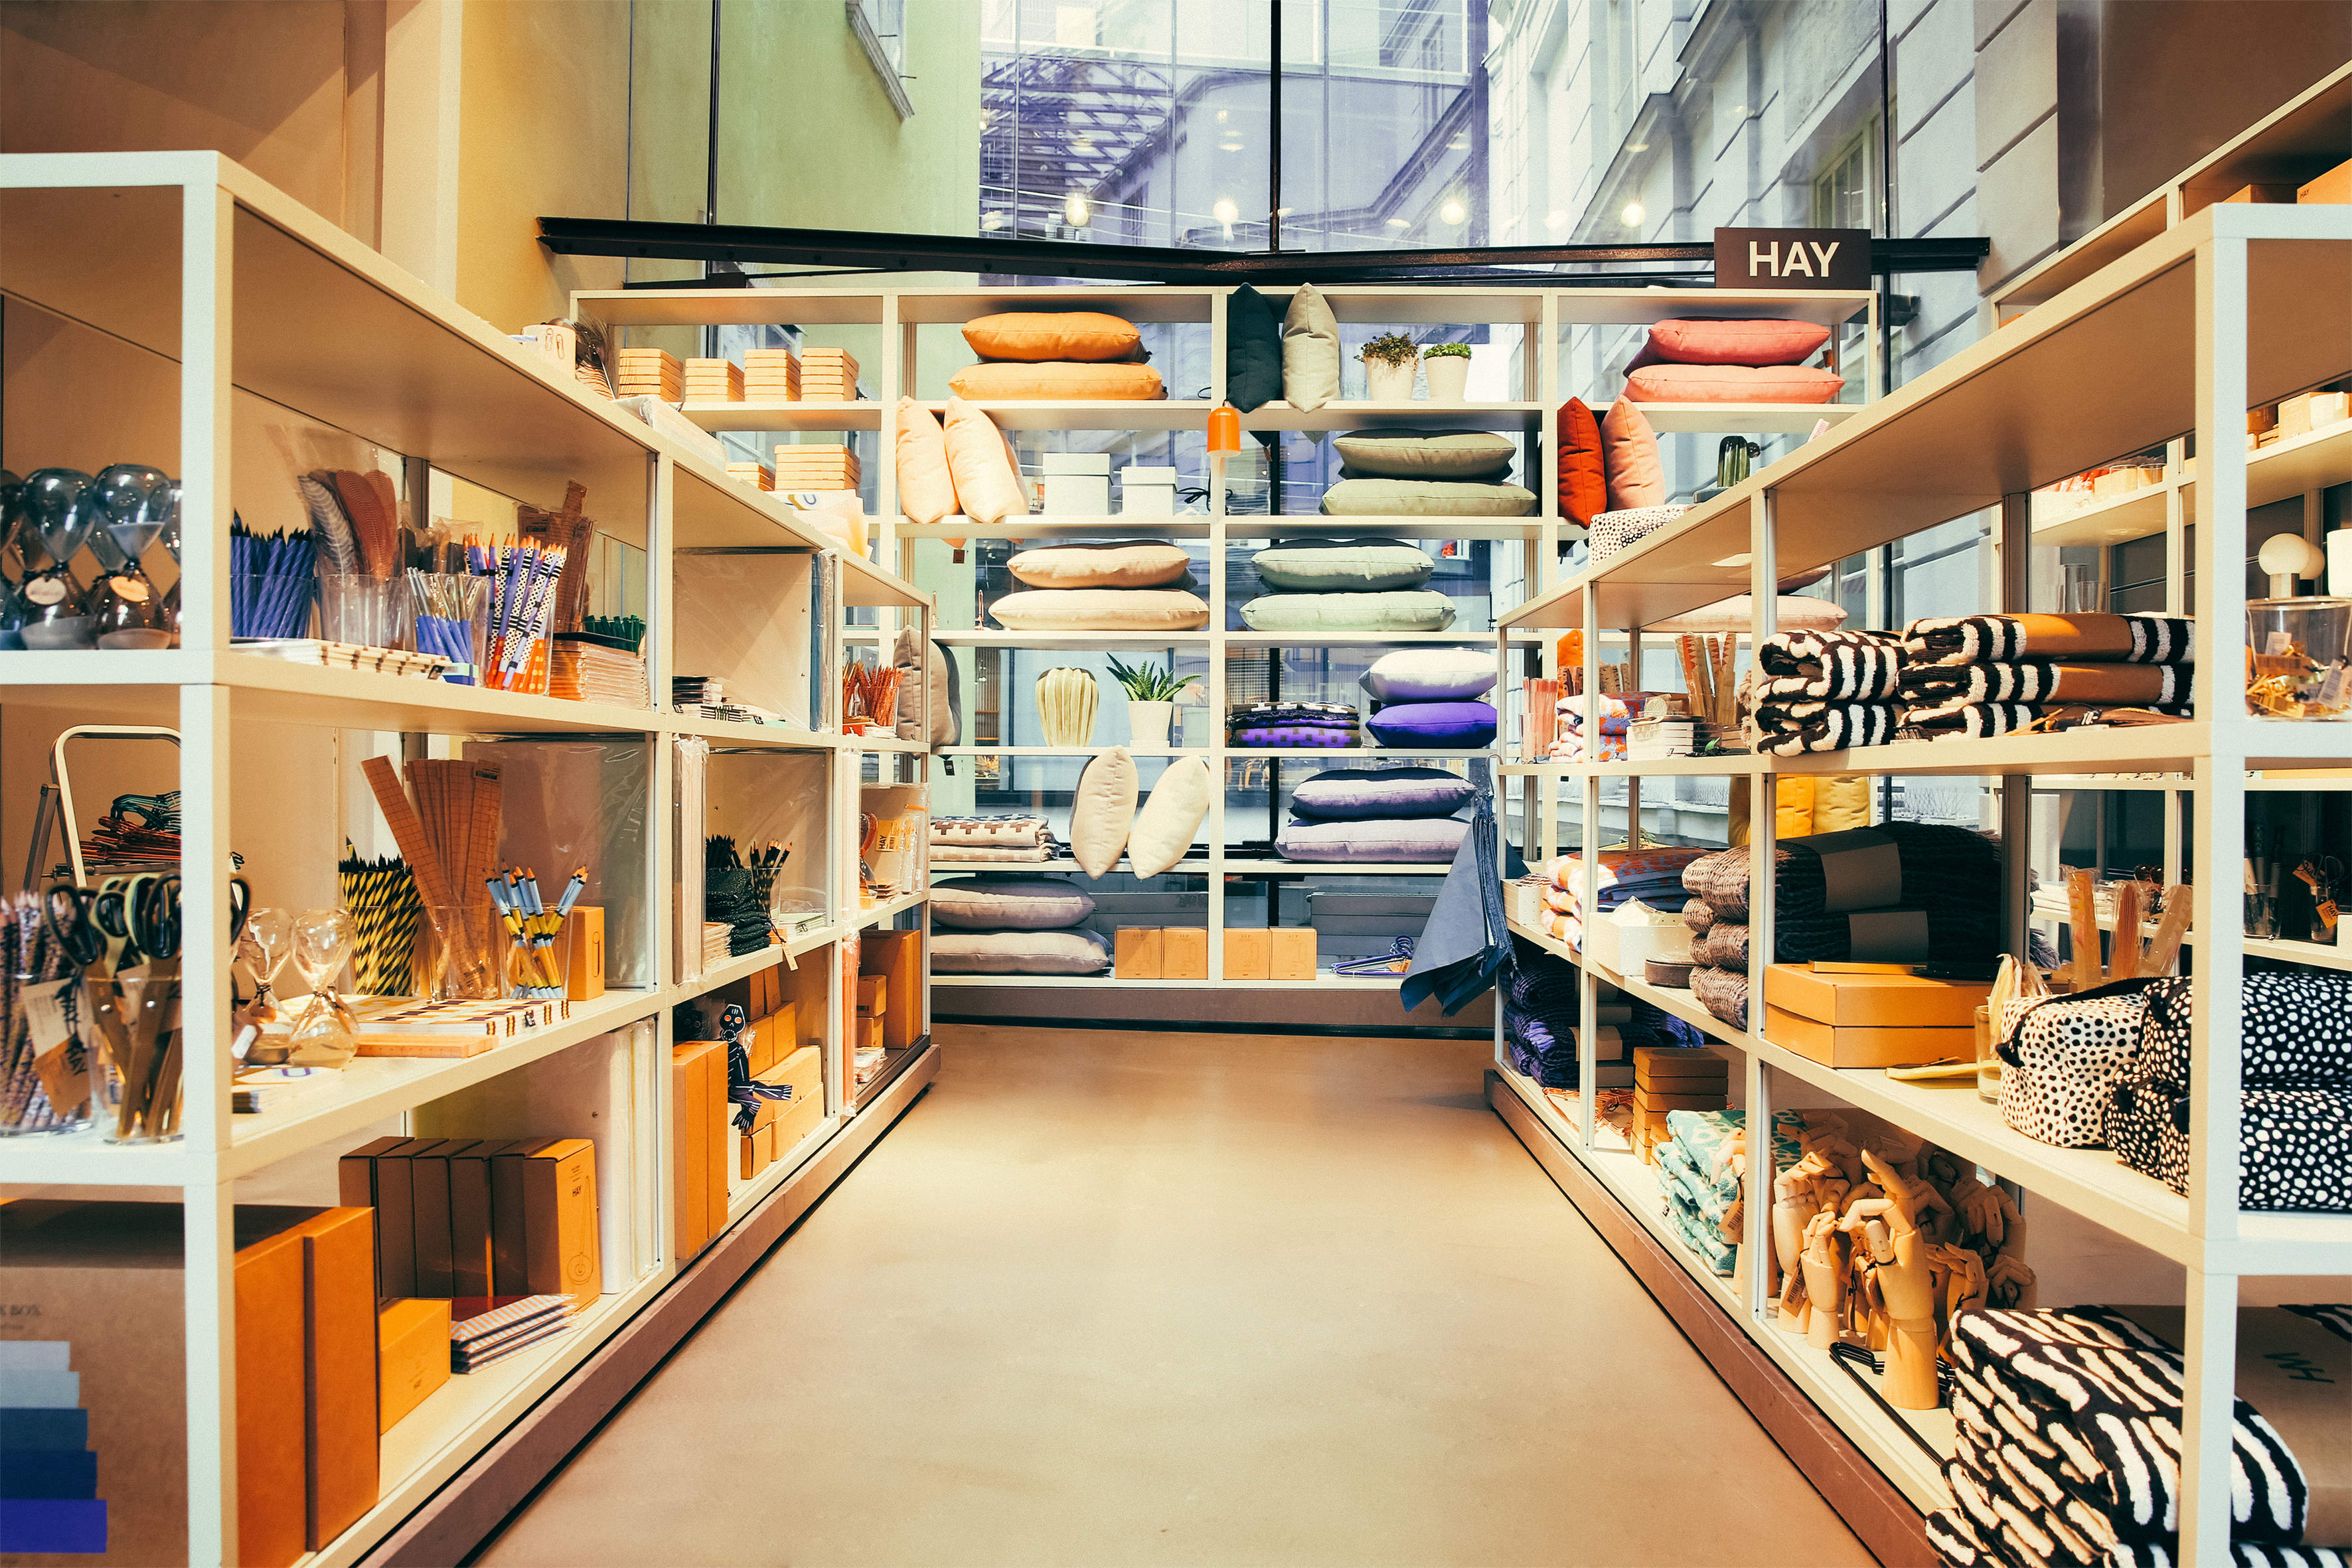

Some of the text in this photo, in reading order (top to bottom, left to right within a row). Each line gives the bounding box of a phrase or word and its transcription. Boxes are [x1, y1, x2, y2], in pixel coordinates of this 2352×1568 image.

[1749, 241, 1840, 277] HAY
[878, 834, 887, 850] HAY
[2327, 905, 2338, 917] HAY
[572, 1184, 582, 1198] HAY
